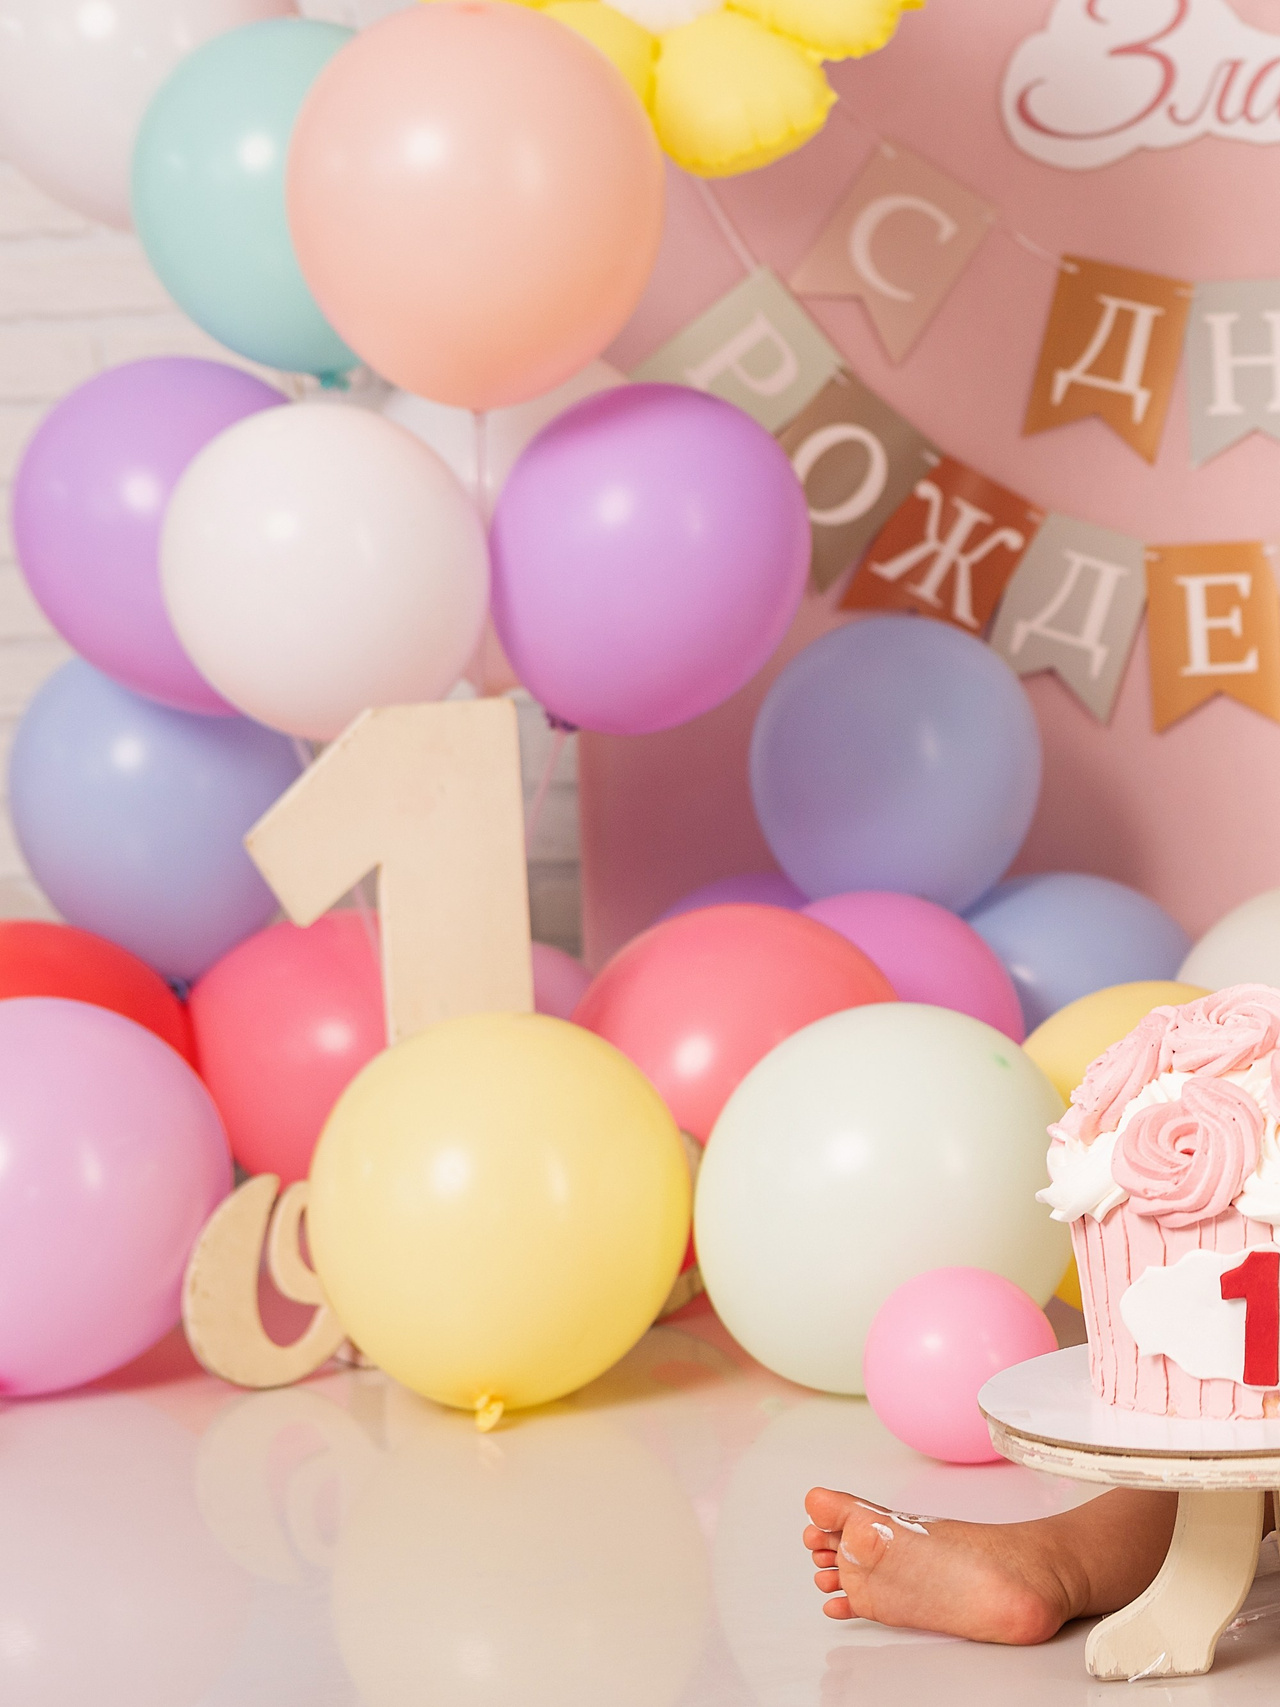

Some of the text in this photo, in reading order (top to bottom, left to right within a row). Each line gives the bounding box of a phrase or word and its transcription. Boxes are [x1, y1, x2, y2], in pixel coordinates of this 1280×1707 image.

[848, 195, 957, 301] С
[244, 697, 534, 1048] 1
[1220, 1251, 1280, 1386] 1
